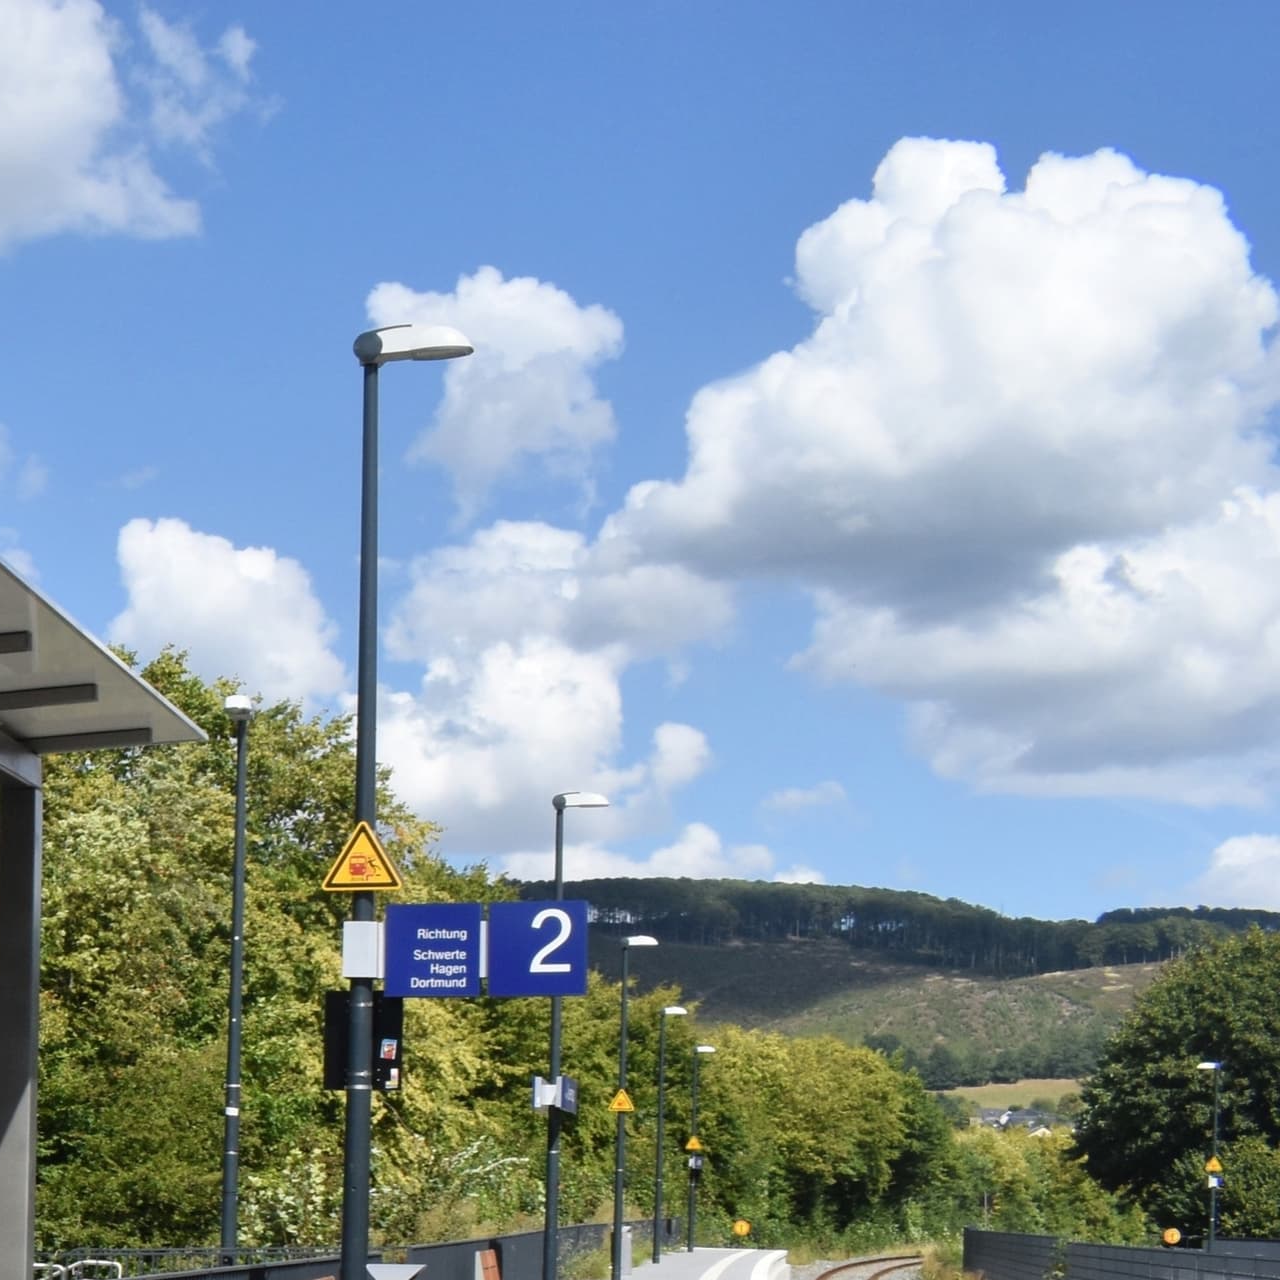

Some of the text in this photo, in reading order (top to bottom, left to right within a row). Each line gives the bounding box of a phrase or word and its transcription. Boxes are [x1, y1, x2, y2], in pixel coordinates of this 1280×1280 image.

[417, 928, 467, 941] Richtung
[529, 907, 572, 973] 2
[413, 949, 466, 961] Schwerte
[430, 964, 466, 976] Hagen
[410, 977, 466, 988] Dortmund
